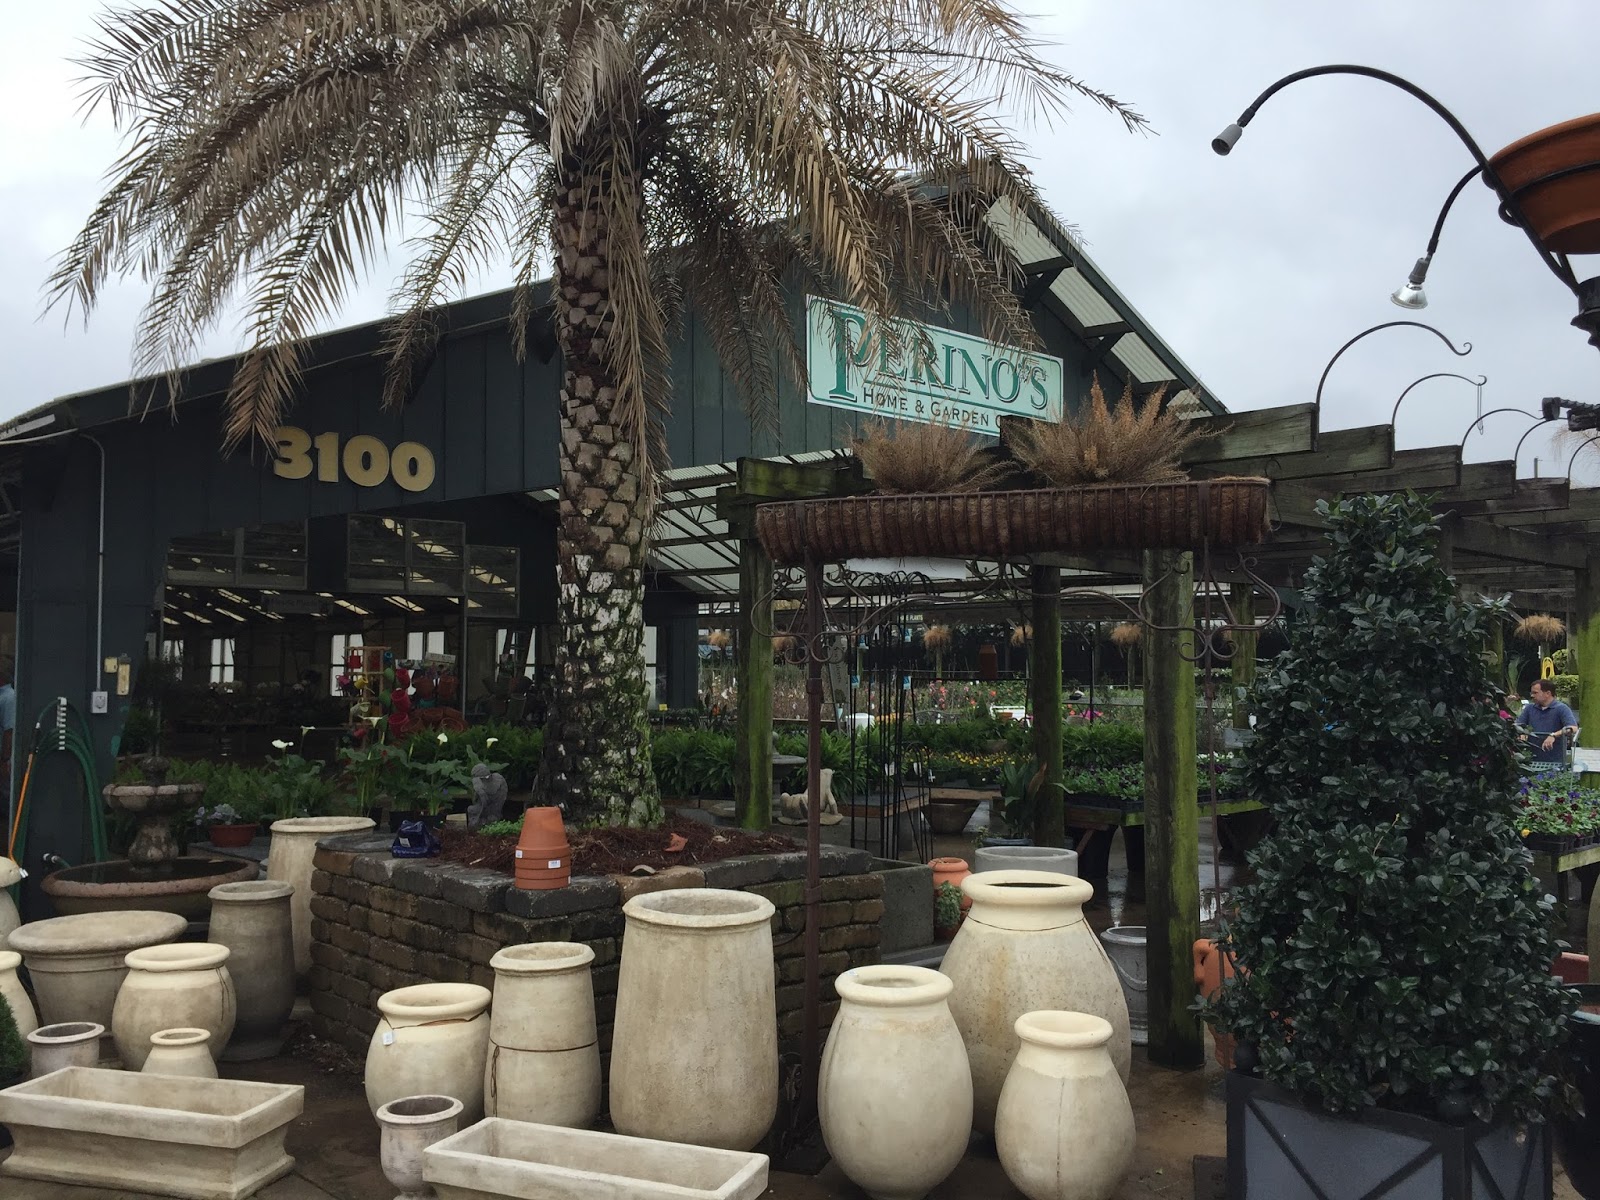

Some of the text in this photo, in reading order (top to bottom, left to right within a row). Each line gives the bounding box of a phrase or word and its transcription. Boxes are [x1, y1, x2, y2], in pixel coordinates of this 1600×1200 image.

[863, 387, 908, 412] HOME
[914, 399, 925, 415] &
[930, 401, 989, 427] GARDEN
[273, 425, 436, 492] 3100
